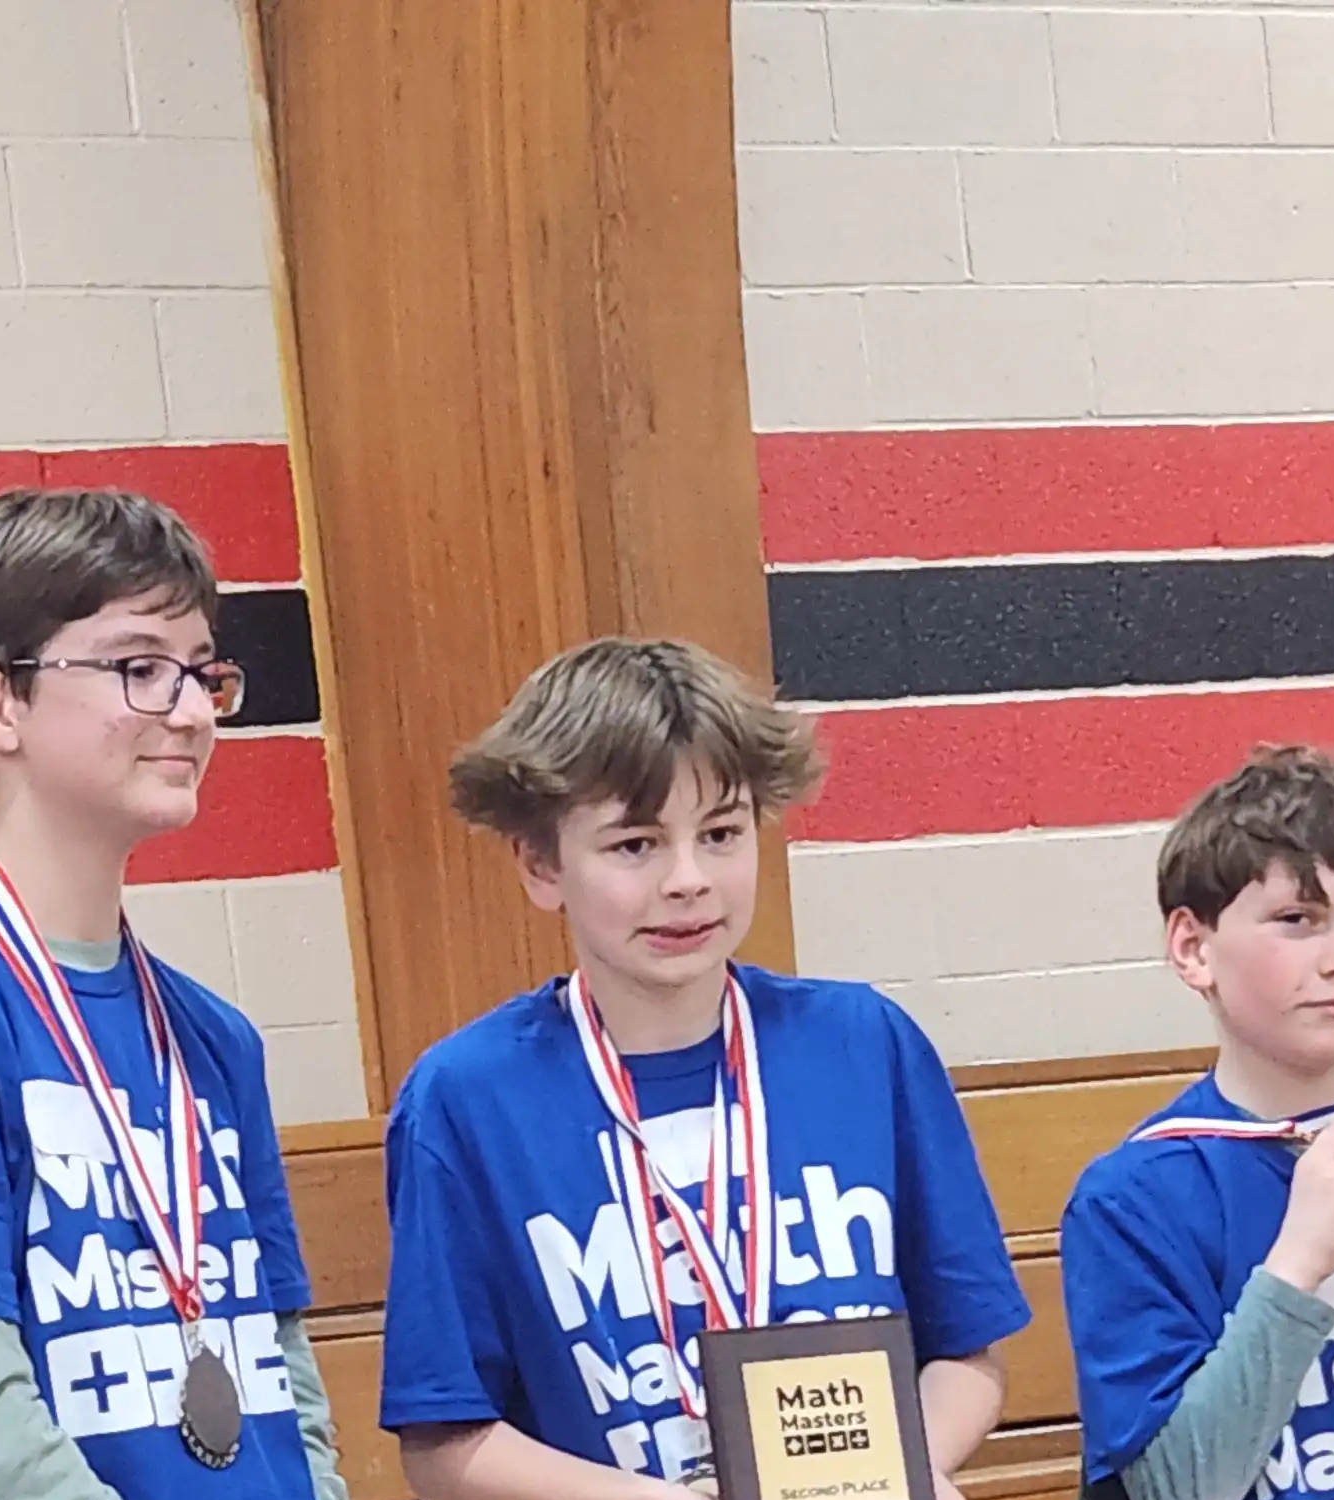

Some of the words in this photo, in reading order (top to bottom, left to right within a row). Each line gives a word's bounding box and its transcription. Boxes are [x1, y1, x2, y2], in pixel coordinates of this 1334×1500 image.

[26, 1232, 261, 1324] Mser
[775, 1378, 864, 1412] Math
[779, 1410, 867, 1432] Masters
